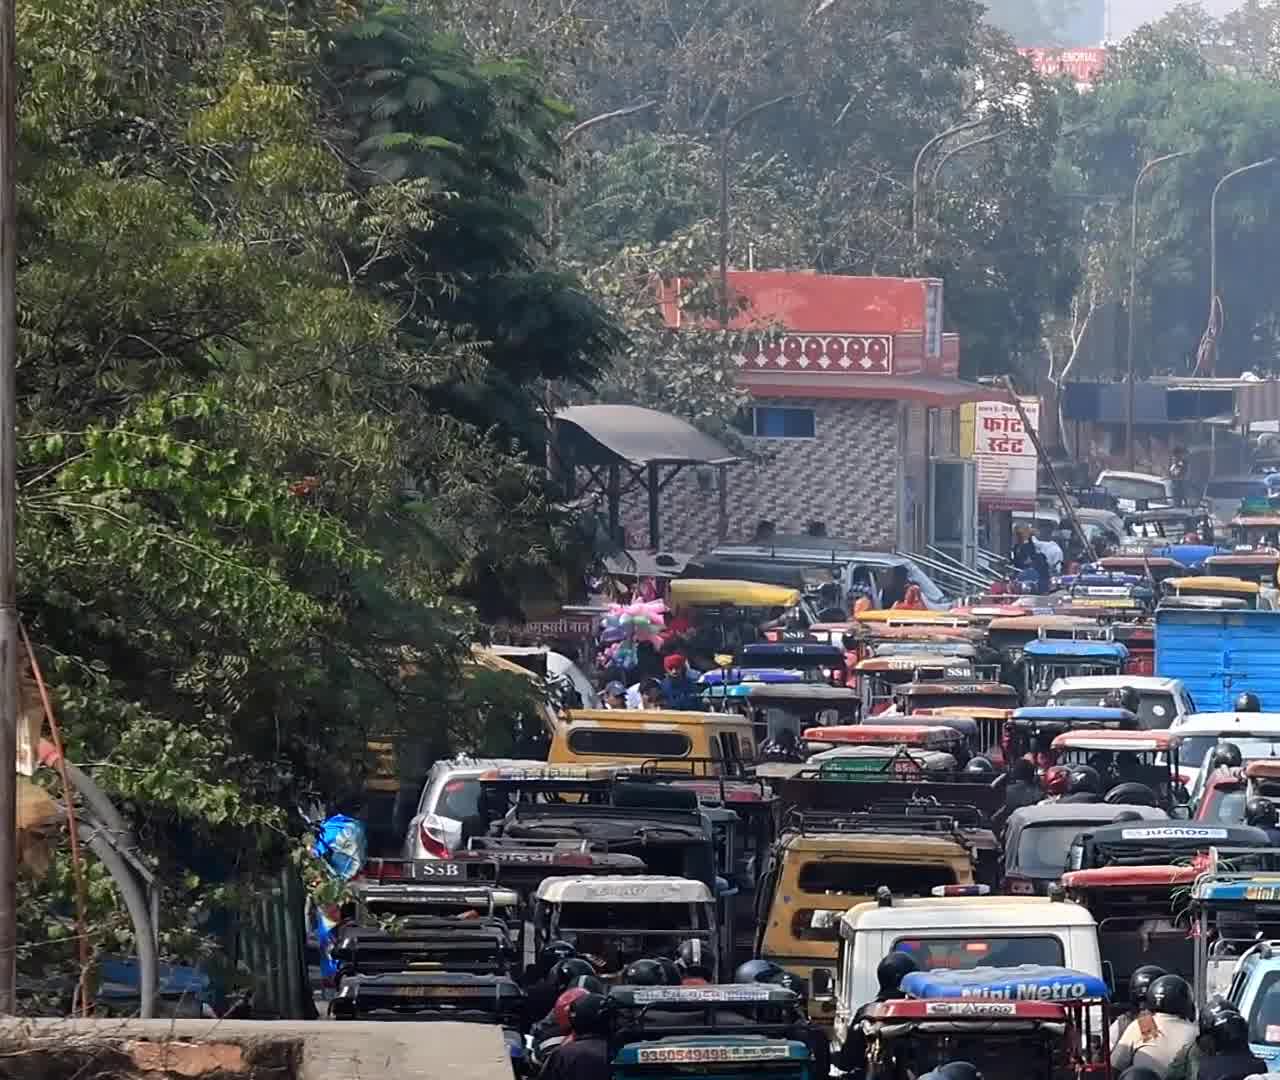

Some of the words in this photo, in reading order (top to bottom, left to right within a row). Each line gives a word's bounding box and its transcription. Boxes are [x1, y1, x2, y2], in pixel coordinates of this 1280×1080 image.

[946, 666, 972, 678] SSB
[423, 864, 460, 877] SSB
[961, 985, 1011, 1000] Mini
[1016, 982, 1086, 1000] Metro
